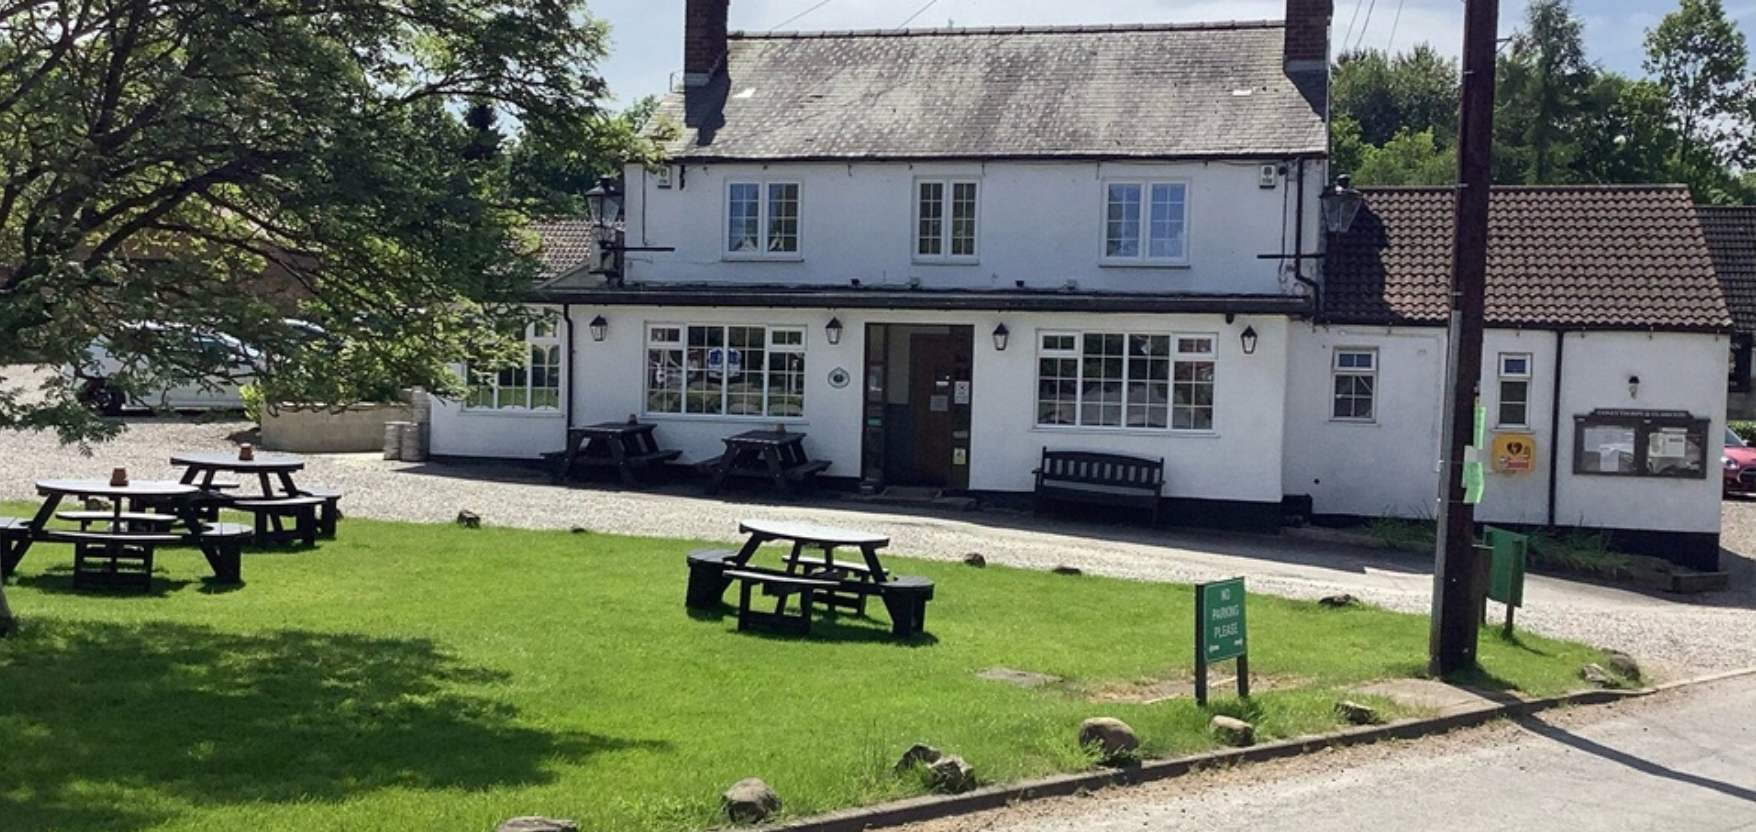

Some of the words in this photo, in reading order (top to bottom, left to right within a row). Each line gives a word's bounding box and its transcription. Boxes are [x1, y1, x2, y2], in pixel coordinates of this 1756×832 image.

[1221, 588, 1231, 601] NO
[1212, 604, 1239, 620] PARKING
[1214, 622, 1239, 638] PLEASE
